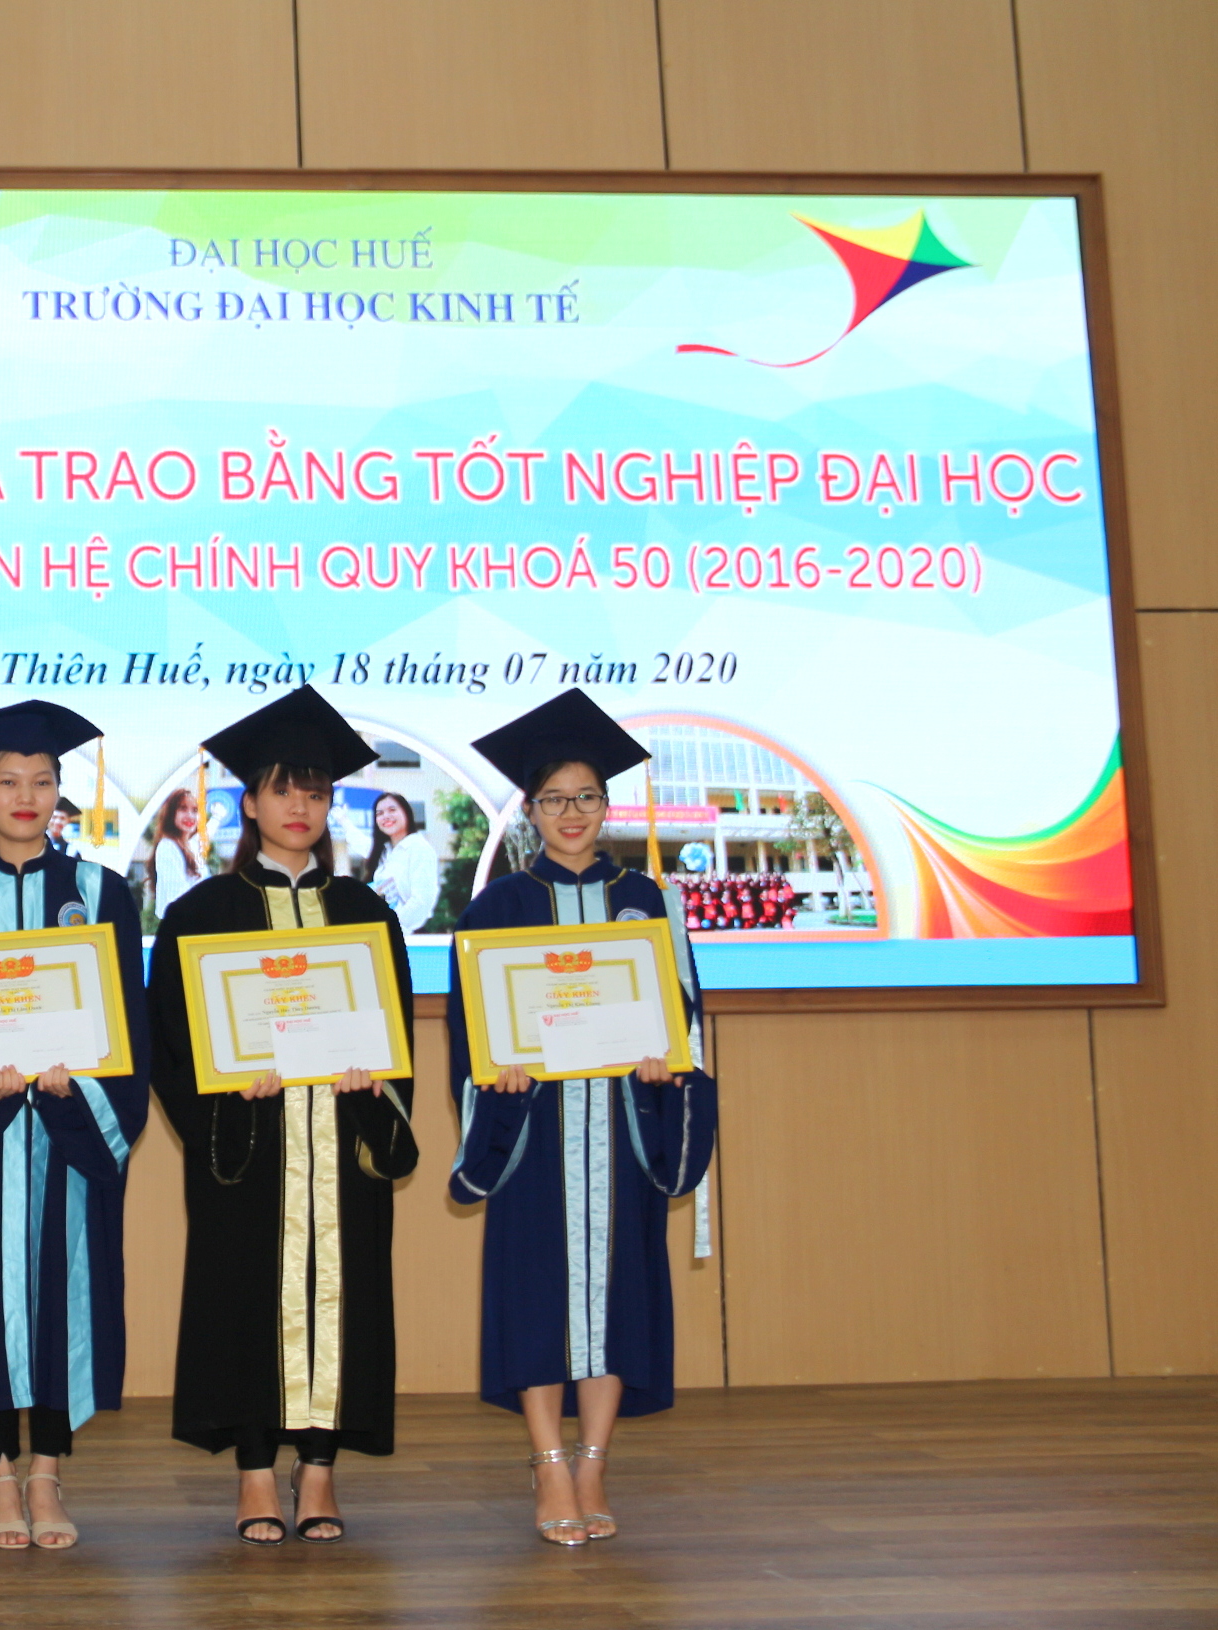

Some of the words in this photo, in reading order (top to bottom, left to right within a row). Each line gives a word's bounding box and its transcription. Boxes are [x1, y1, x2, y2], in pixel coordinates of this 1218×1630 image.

[169, 238, 240, 273] ĐẠI
[254, 238, 338, 274] HỌC
[351, 226, 433, 269] HUẾ
[22, 281, 203, 321] TRƯỜNG
[216, 291, 290, 329] ĐẠI
[304, 291, 395, 330] HỌC
[408, 292, 515, 323] KINH
[526, 279, 580, 323] TẾ
[18, 449, 197, 502] TRAO
[220, 428, 399, 503] BẰNG
[414, 433, 546, 503] TỐT
[565, 441, 800, 515] NGHIỆP
[816, 452, 919, 515] ĐẠI
[941, 452, 1083, 516] HỌC
[43, 535, 111, 599] HỆ
[128, 536, 301, 590] CHÍNH
[319, 545, 434, 592] QUY
[449, 536, 598, 590] KHOÁ
[613, 545, 672, 590] 50
[688, 545, 984, 594] (2016-2020)
[2, 652, 109, 686] Thiên
[120, 643, 211, 690] Huế,
[225, 652, 316, 694] ngày
[329, 652, 371, 685] 18
[383, 652, 490, 693] tháng
[503, 653, 548, 686] 07
[558, 654, 638, 687] năm
[651, 652, 738, 685] 2020
